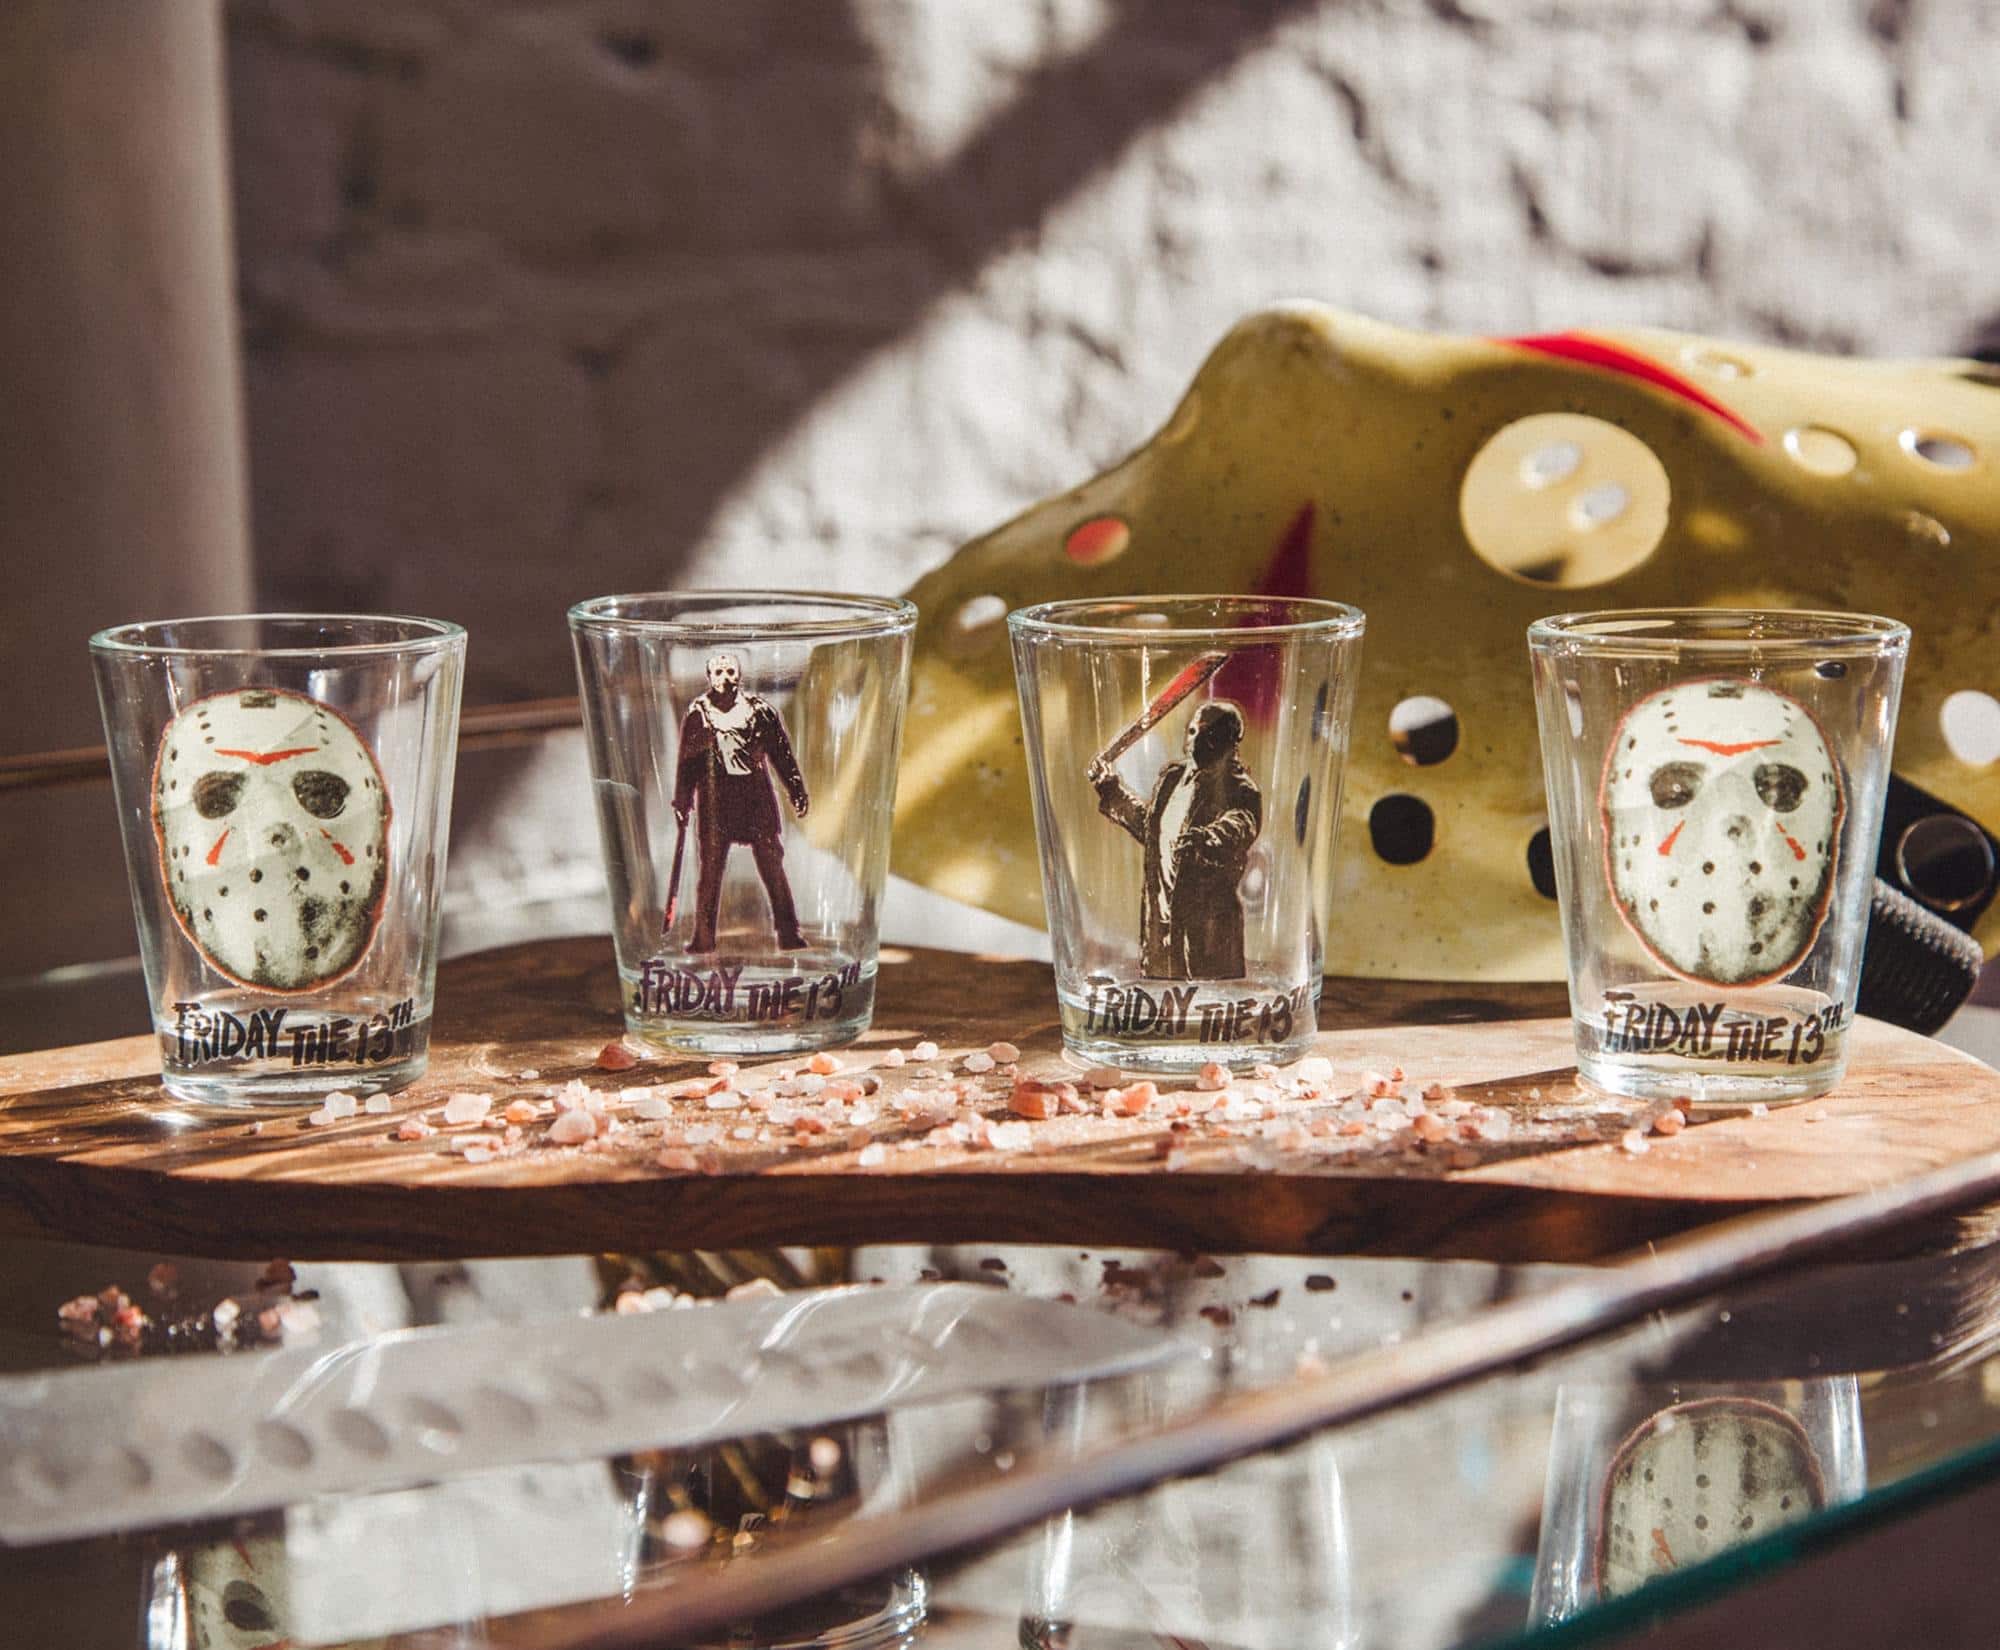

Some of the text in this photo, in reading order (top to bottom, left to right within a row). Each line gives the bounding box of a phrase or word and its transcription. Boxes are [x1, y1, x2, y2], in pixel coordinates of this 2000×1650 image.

[639, 959, 743, 1015] FRIDAY
[743, 977, 804, 1019] THE
[1085, 976, 1199, 1035] FRIDAY
[1195, 998, 1257, 1043] THE
[174, 1002, 287, 1063] FRIDAY
[286, 1018, 353, 1065] THE
[1602, 991, 1725, 1052] FRIDAY
[1723, 1017, 1788, 1062] THE
